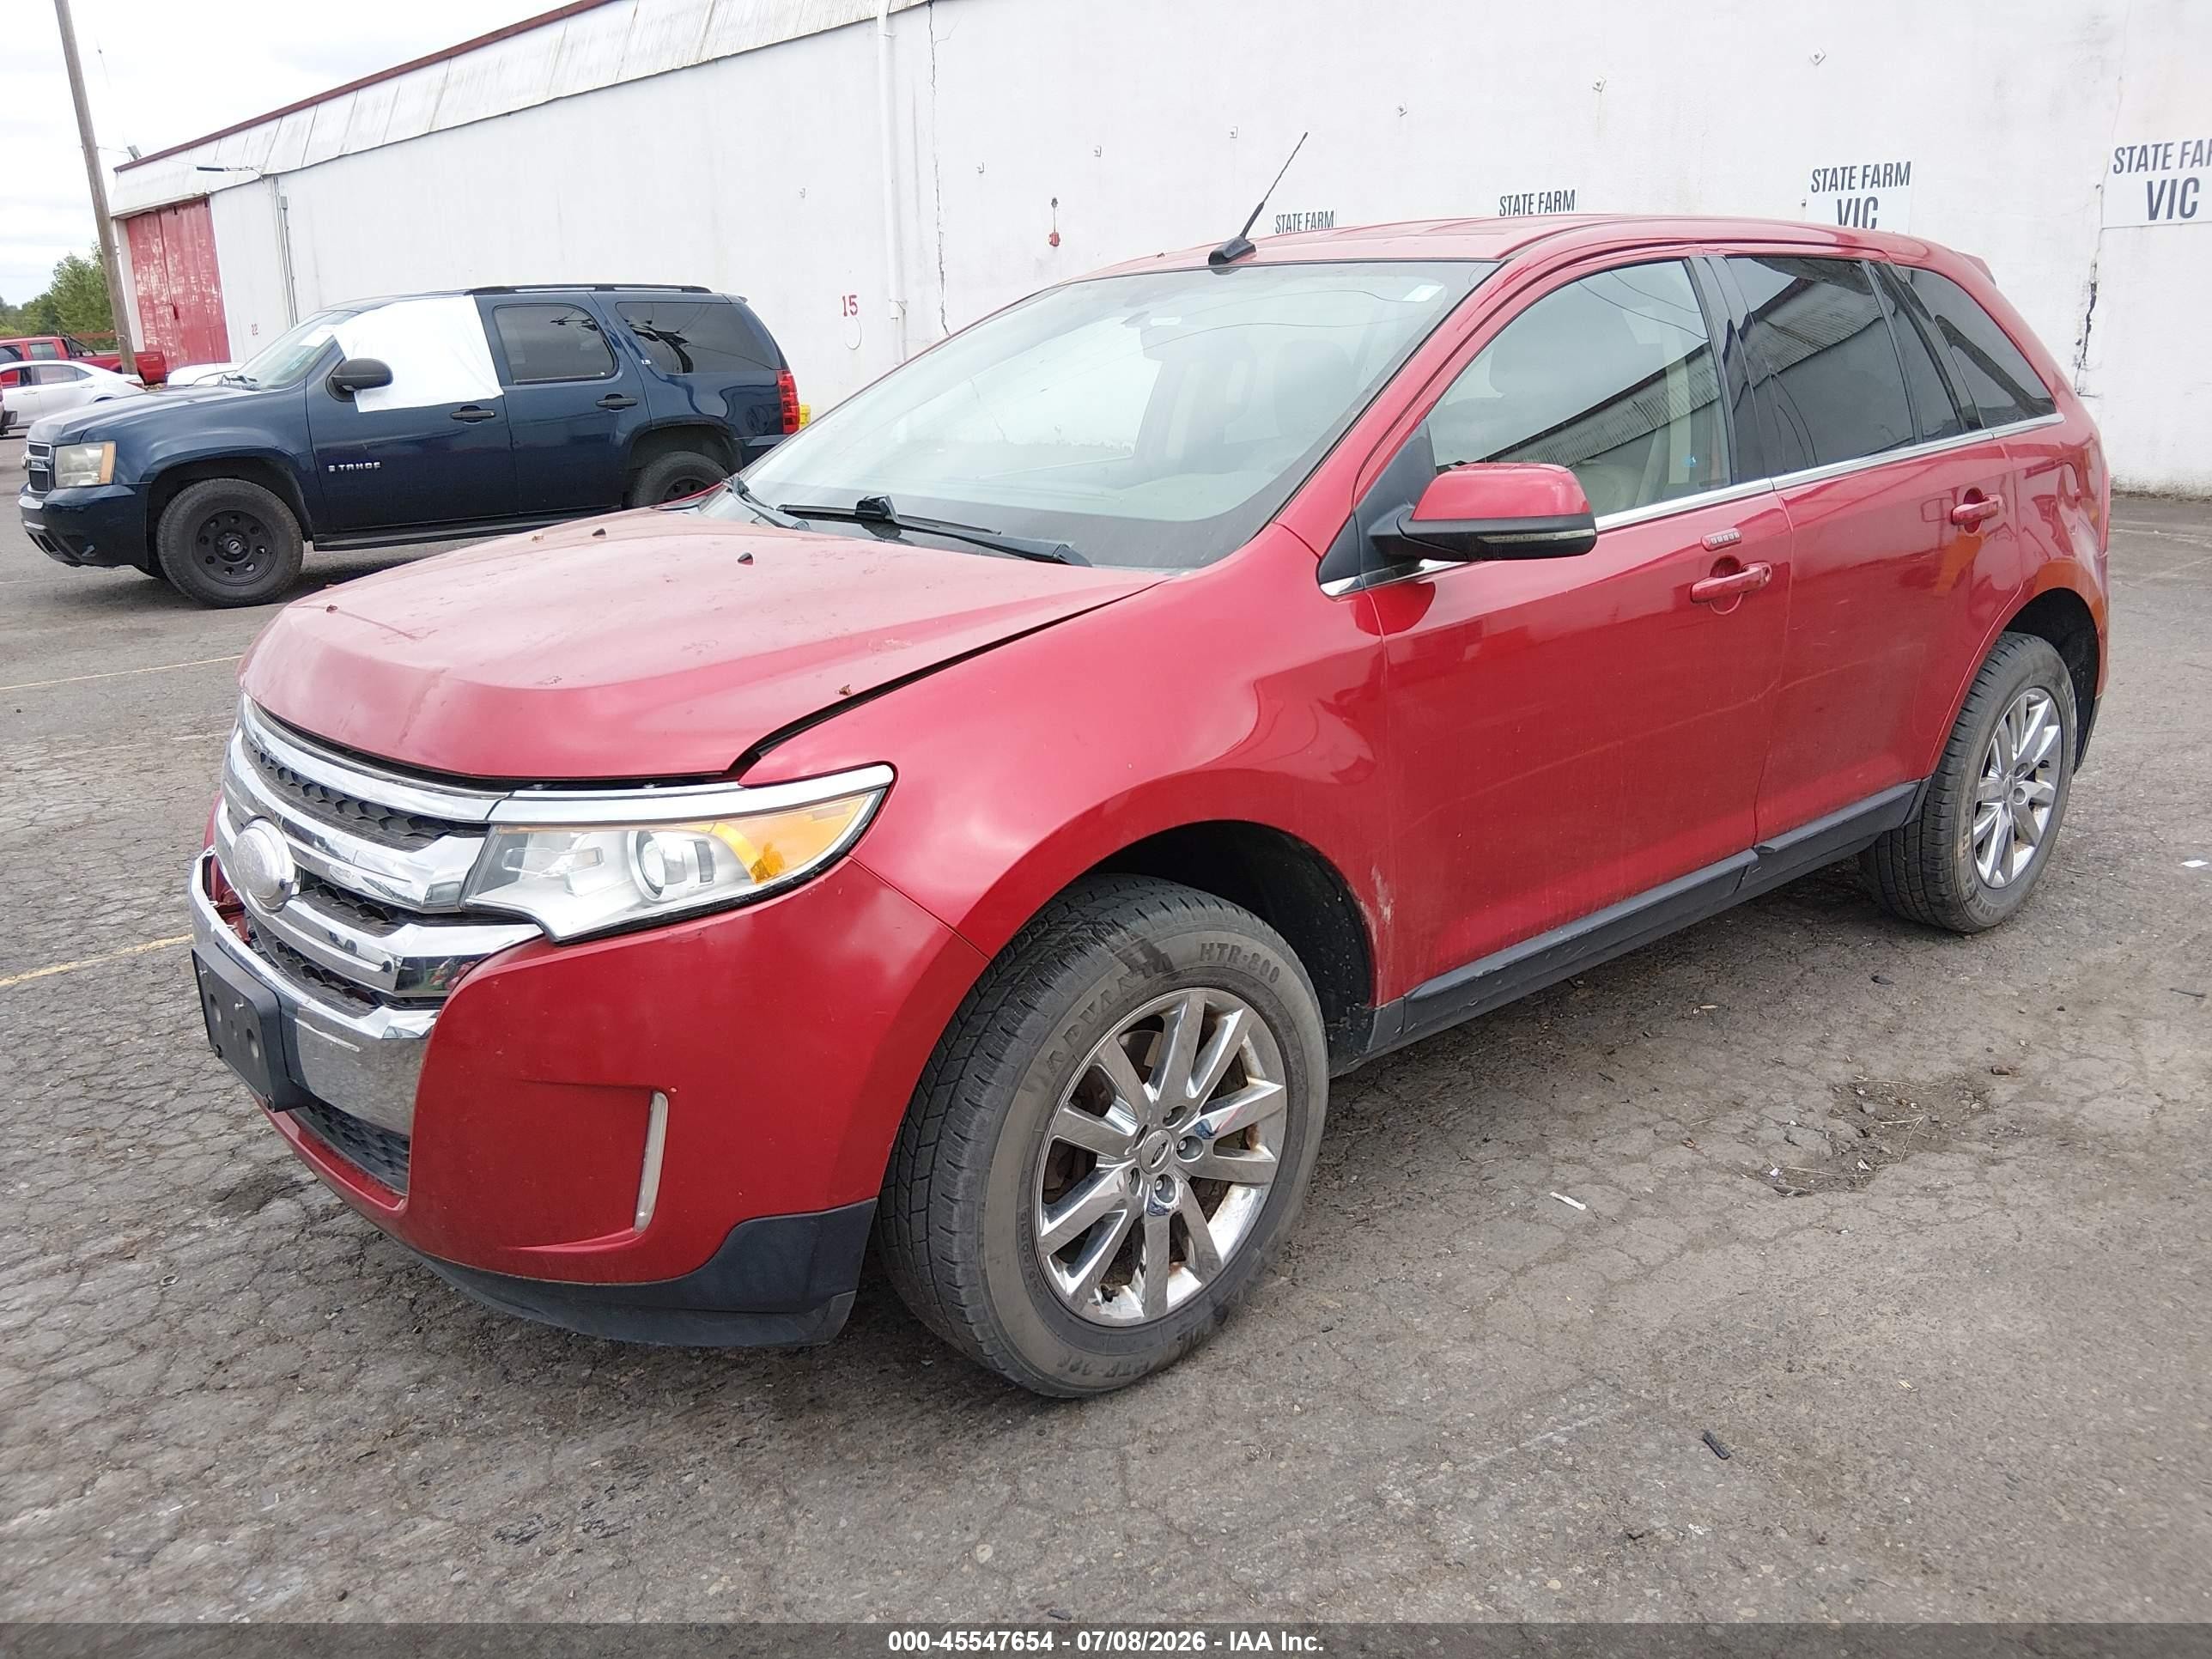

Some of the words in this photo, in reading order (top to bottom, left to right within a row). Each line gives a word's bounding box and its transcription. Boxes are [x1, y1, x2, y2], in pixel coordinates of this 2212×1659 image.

[2113, 143, 2174, 174] STATE
[1811, 166, 1857, 193] STATE
[1861, 161, 1911, 190] FARM
[1499, 193, 1534, 216] STATE
[1538, 189, 1575, 214] FARM
[1837, 197, 1879, 229] VIC
[2146, 177, 2200, 221] VIC
[1275, 213, 1303, 234] STATE
[1305, 210, 1334, 231] FARM
[842, 295, 858, 317] 15
[338, 461, 380, 471] TAHOE
